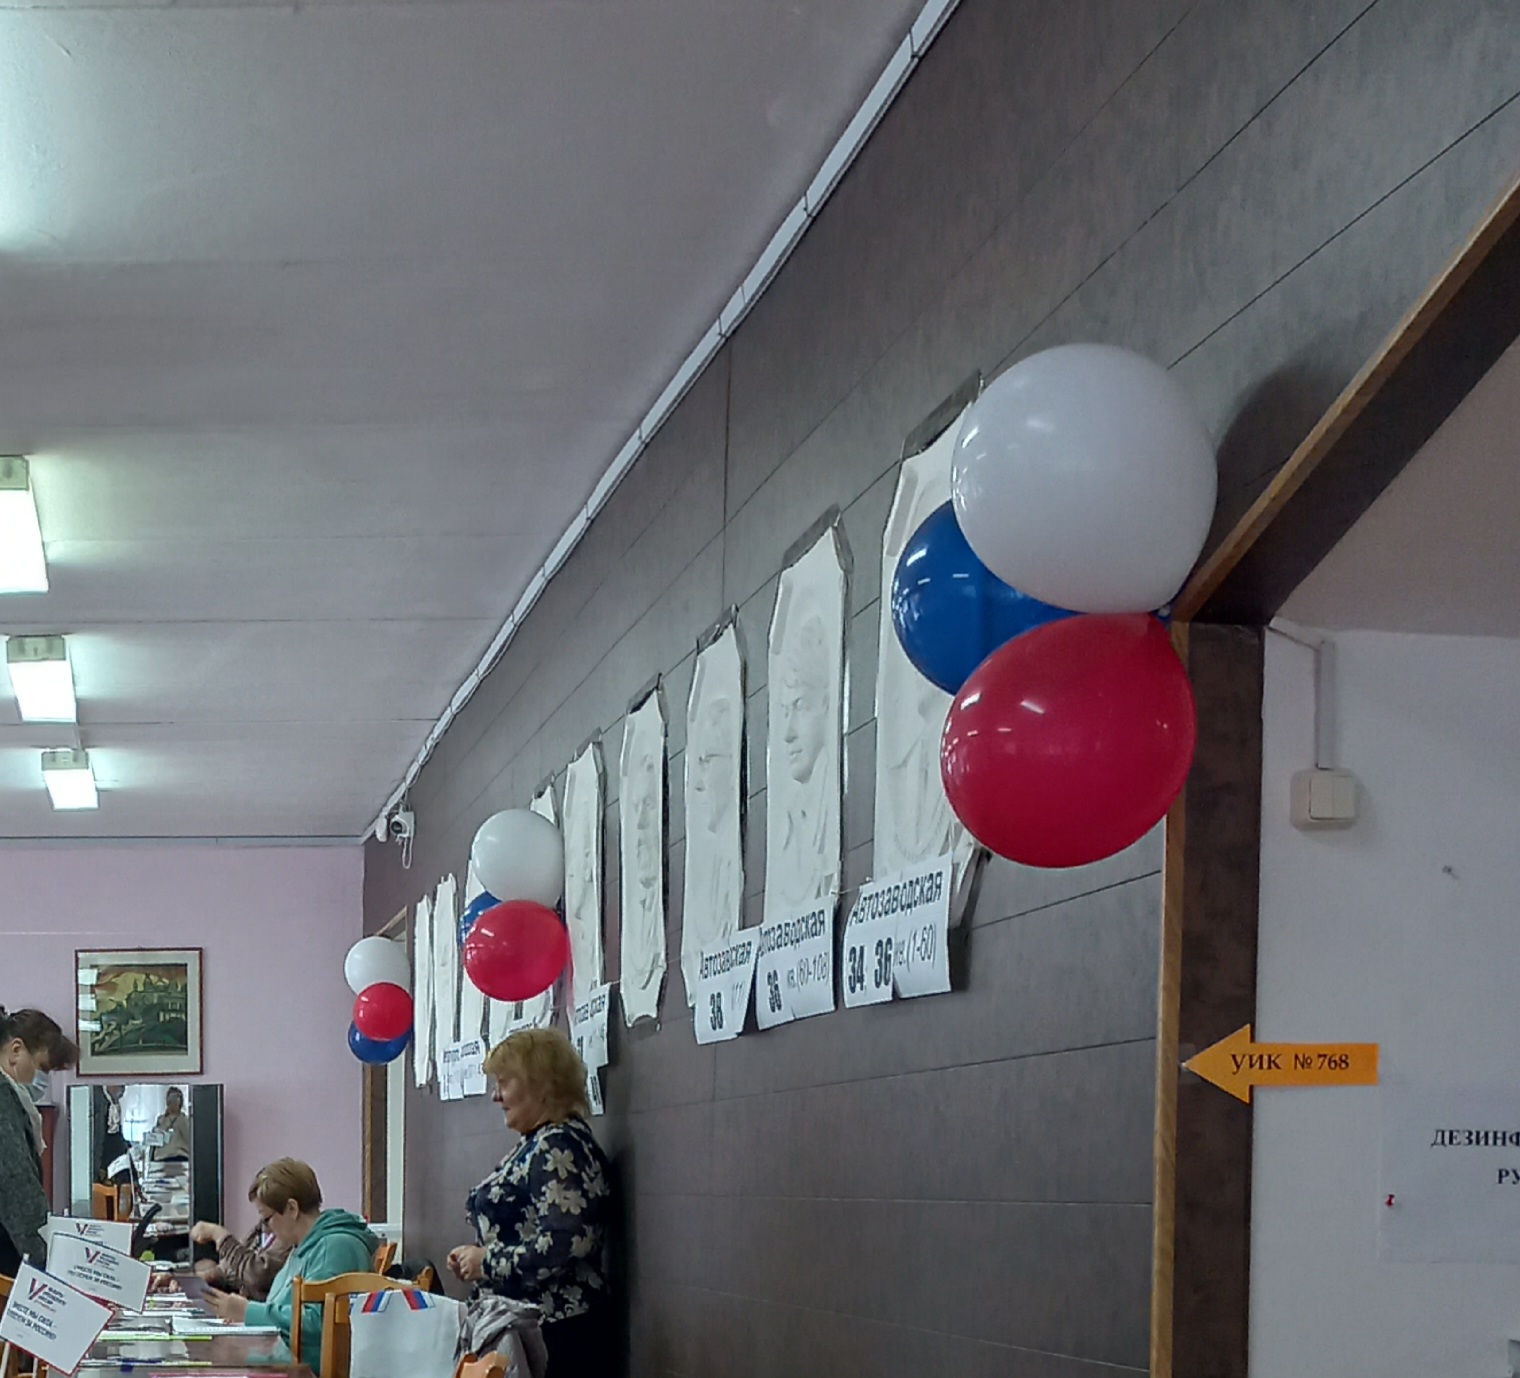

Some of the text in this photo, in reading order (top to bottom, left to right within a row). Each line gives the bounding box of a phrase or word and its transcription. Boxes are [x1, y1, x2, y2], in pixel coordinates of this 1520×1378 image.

[848, 871, 943, 927] Автозаводская
[874, 937, 893, 989] 36
[1230, 1054, 1283, 1075] УИК
[1317, 1053, 1350, 1070] 768
